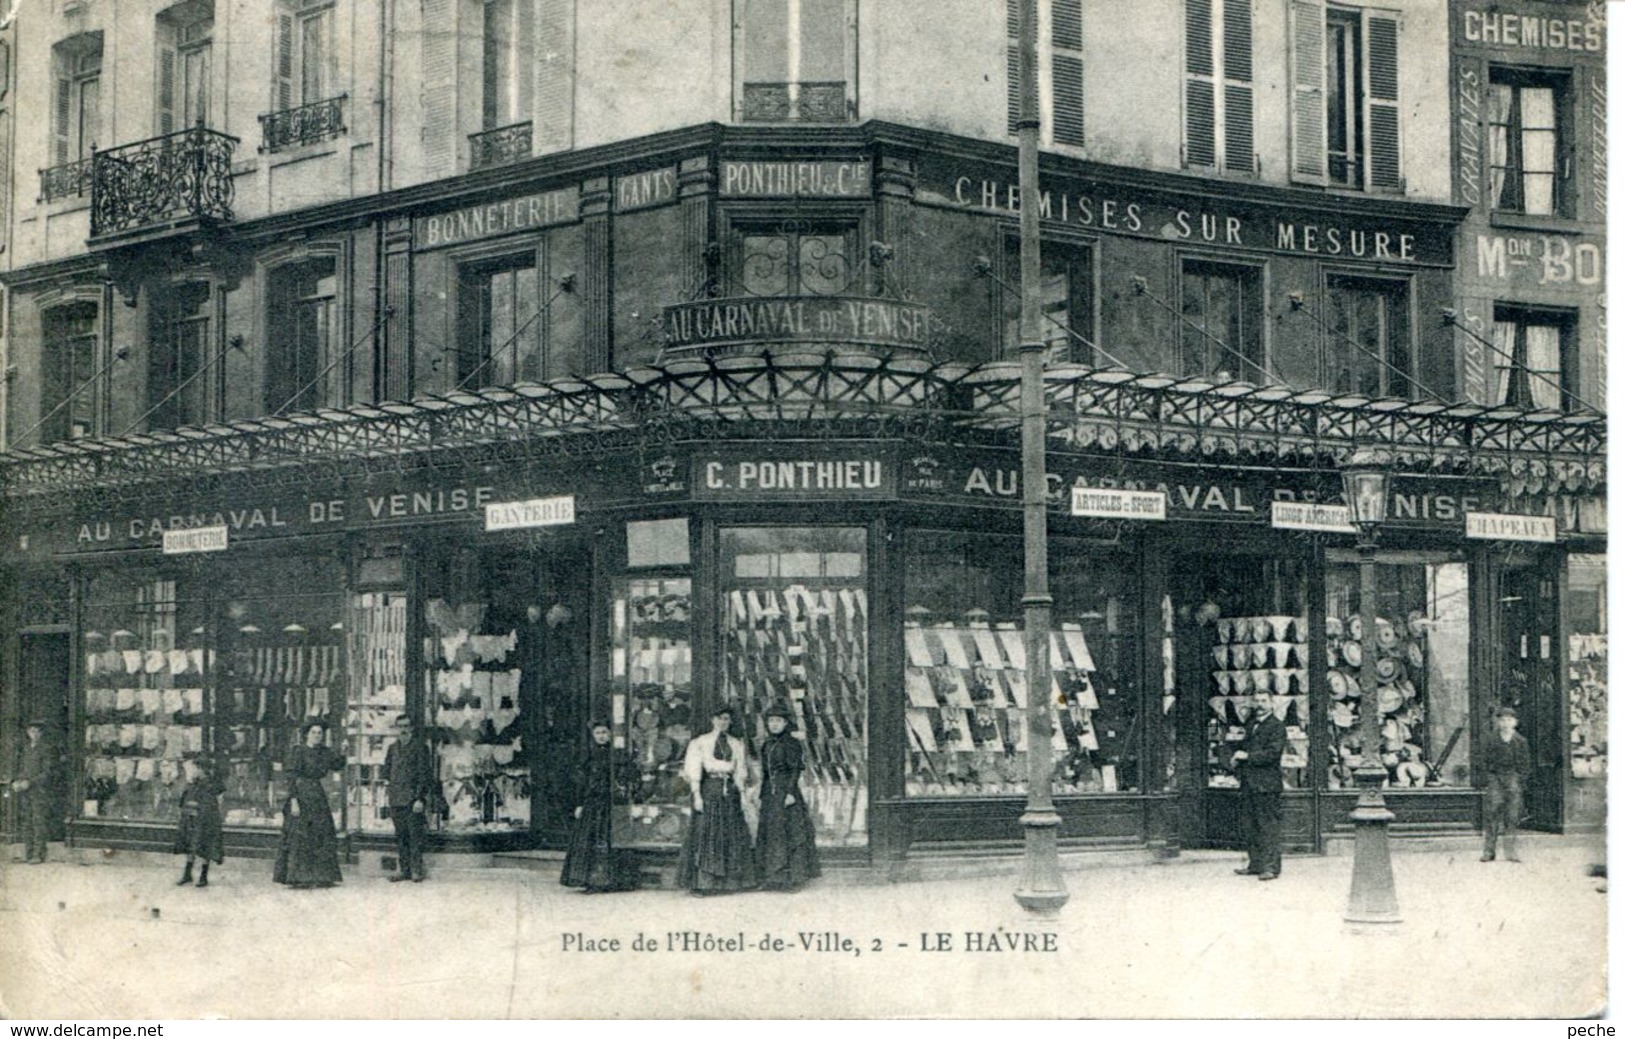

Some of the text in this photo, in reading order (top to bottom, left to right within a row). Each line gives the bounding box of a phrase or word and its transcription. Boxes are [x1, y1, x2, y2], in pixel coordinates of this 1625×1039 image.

[1465, 10, 1601, 51] CHEMISES
[1460, 64, 1479, 204] CRAVATES
[621, 171, 673, 207] GANTS
[726, 164, 822, 194] PONTHIEU
[427, 196, 566, 245] BONNETERIE
[955, 176, 1415, 260] CHEMISES SUR MESURE
[1539, 235, 1601, 285] BO
[669, 302, 923, 342] AU CARNAVAL DE VENISE
[706, 461, 881, 489] C. PONTHIEU
[964, 467, 1017, 495] AU
[1341, 492, 1480, 520] NISE
[77, 522, 111, 543] AU
[309, 500, 344, 523] DE
[366, 486, 494, 519] VENISE
[490, 501, 572, 525] GANTERIE
[1076, 494, 1122, 512] ARTICLES
[1131, 496, 1161, 514] SPORT
[165, 530, 226, 550] BONNETERIE
[1467, 515, 1553, 538] CHAPEAUX
